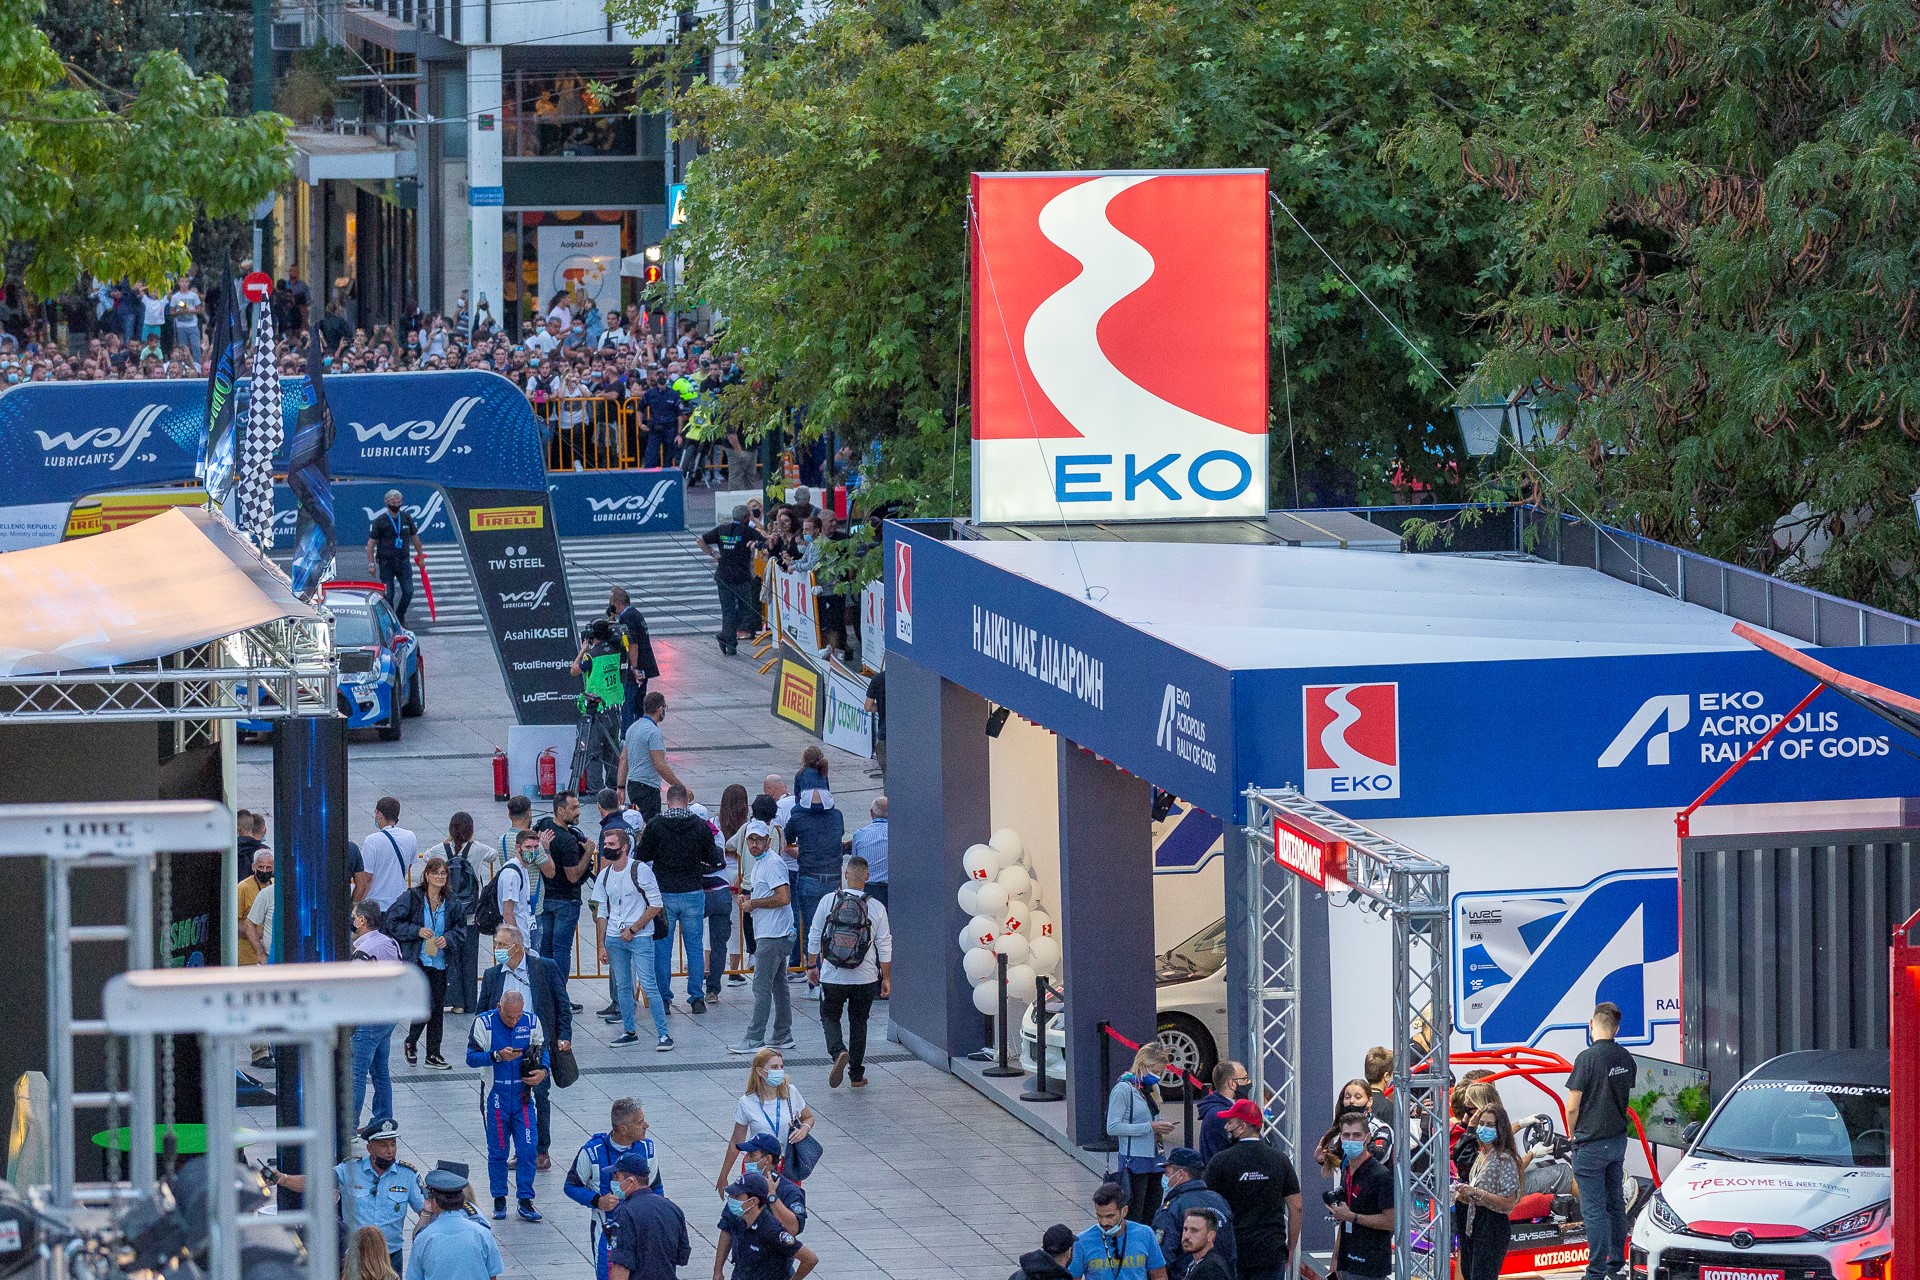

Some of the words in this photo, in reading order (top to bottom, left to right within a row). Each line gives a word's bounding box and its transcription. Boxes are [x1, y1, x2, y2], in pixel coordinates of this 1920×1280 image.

[45, 453, 115, 468] LUBRICANTS
[361, 446, 431, 458] LUBRICANTS
[1055, 450, 1252, 502] EKO
[476, 510, 537, 527] PIRELLI
[593, 512, 642, 522] LUBRICANTS
[489, 559, 507, 570] TW
[509, 558, 545, 569] STEEL
[332, 608, 368, 616] MOTORS
[504, 627, 568, 641] AsahiKASEI
[900, 619, 911, 637] EKO
[512, 659, 574, 671] TotalEnergies
[983, 610, 1010, 666] ΔΙΚΗ
[1012, 621, 1037, 678] ΜΑΣ
[1039, 634, 1103, 711] ΔΙΑΔΡΟΜΗ
[782, 672, 815, 719] PIRELLI
[1176, 687, 1191, 709] EKO
[1700, 691, 1764, 710] EKO
[838, 701, 868, 736] COSMOTE
[1176, 710, 1206, 742] ACROPOLIS
[1700, 711, 1838, 737] ACROPOLIS
[1176, 736, 1193, 761] RALLY
[1193, 744, 1201, 766] OF
[1201, 748, 1216, 773] GODS
[1701, 741, 1770, 763] RALLY
[1780, 738, 1814, 759] OF
[1818, 736, 1889, 757] GODS
[1331, 774, 1393, 793] EKO
[1468, 909, 1502, 918] WRC
[1470, 933, 1483, 941] FIA
[1785, 1083, 1866, 1096] ΚΩΤΣΟΒΟΛΟΣ
[1688, 1178, 1775, 1191] ΤΡΕΧΟΥΜΕ
[1779, 1179, 1793, 1187] ΜΕ
